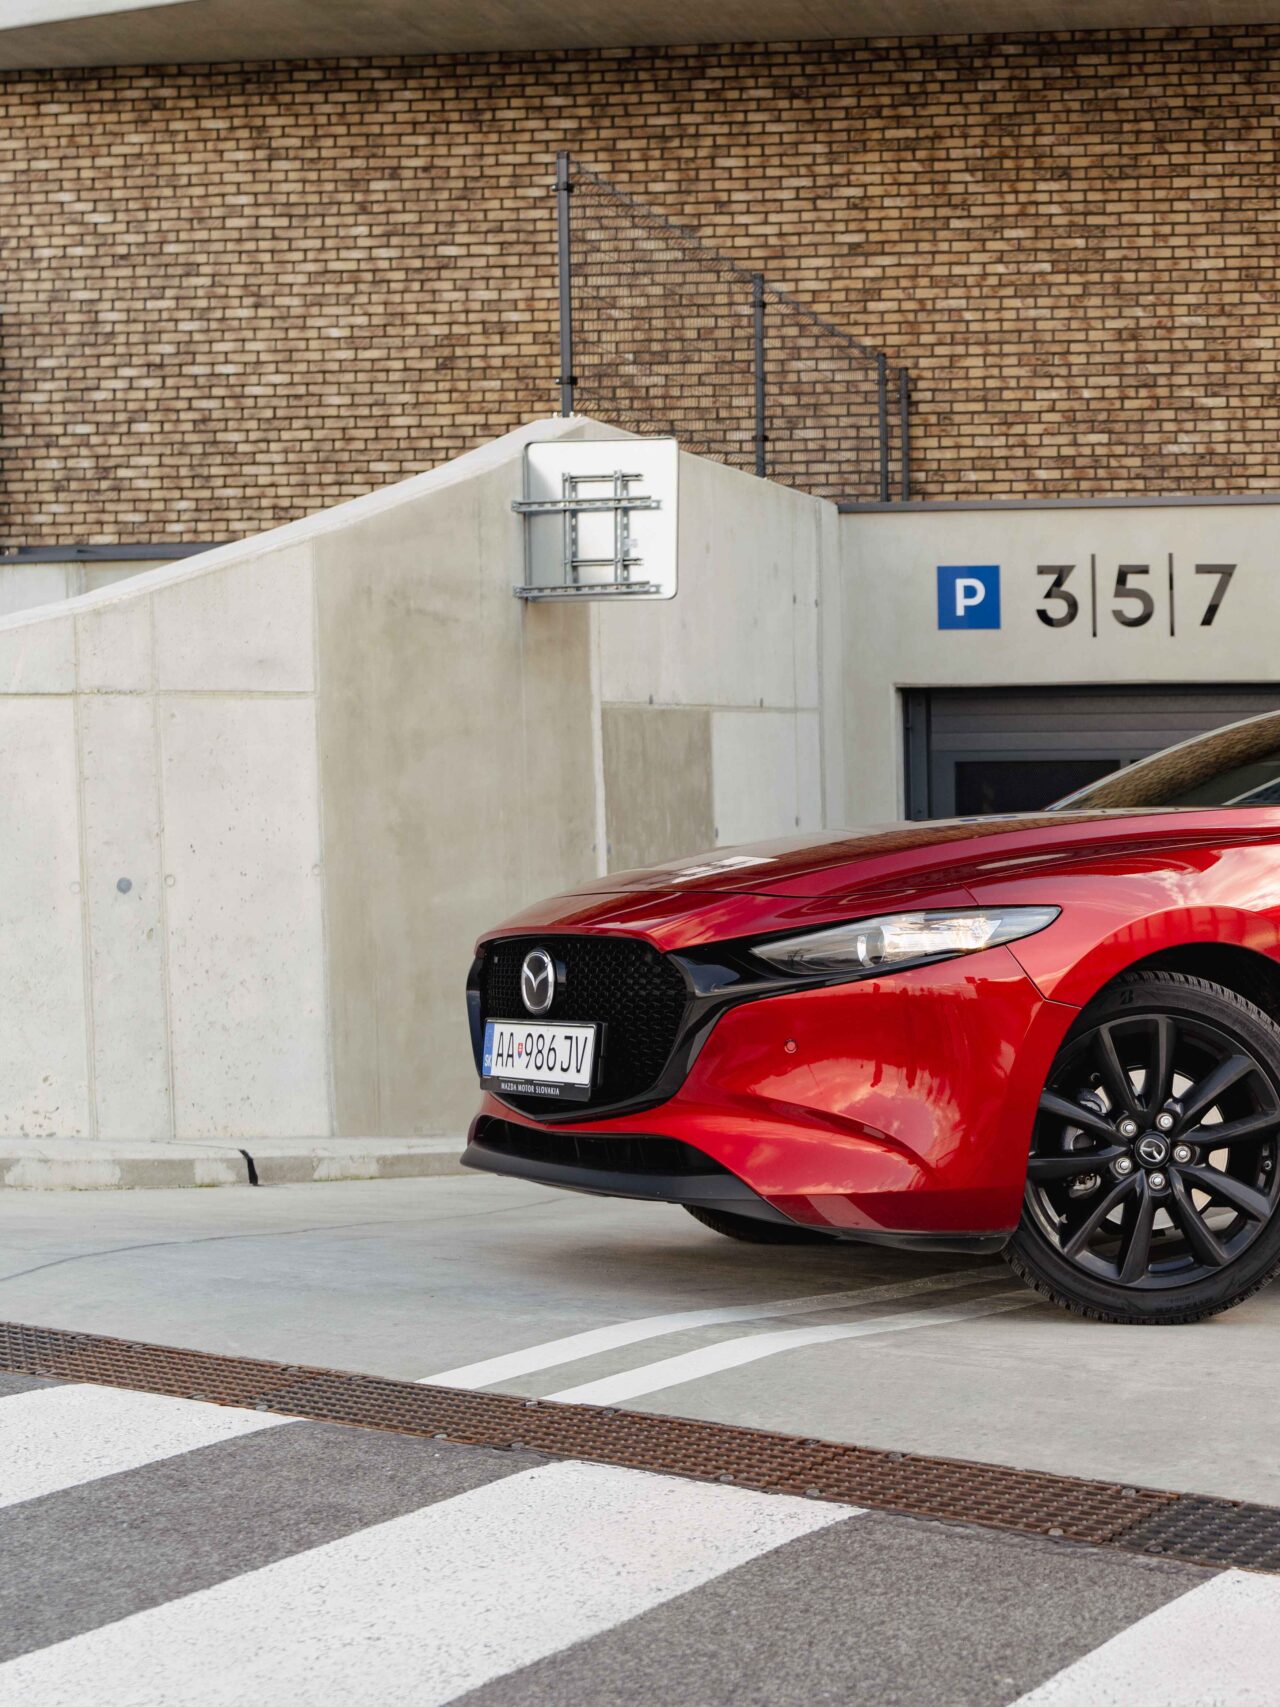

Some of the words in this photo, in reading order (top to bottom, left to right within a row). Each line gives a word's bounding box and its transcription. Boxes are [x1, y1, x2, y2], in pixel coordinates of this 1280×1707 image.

[955, 578, 986, 617] P
[495, 1031, 515, 1068] AA
[501, 1082, 517, 1091] MAZDA
[517, 1084, 535, 1093] MOTOR
[535, 1085, 560, 1095] SLOVAKIA
